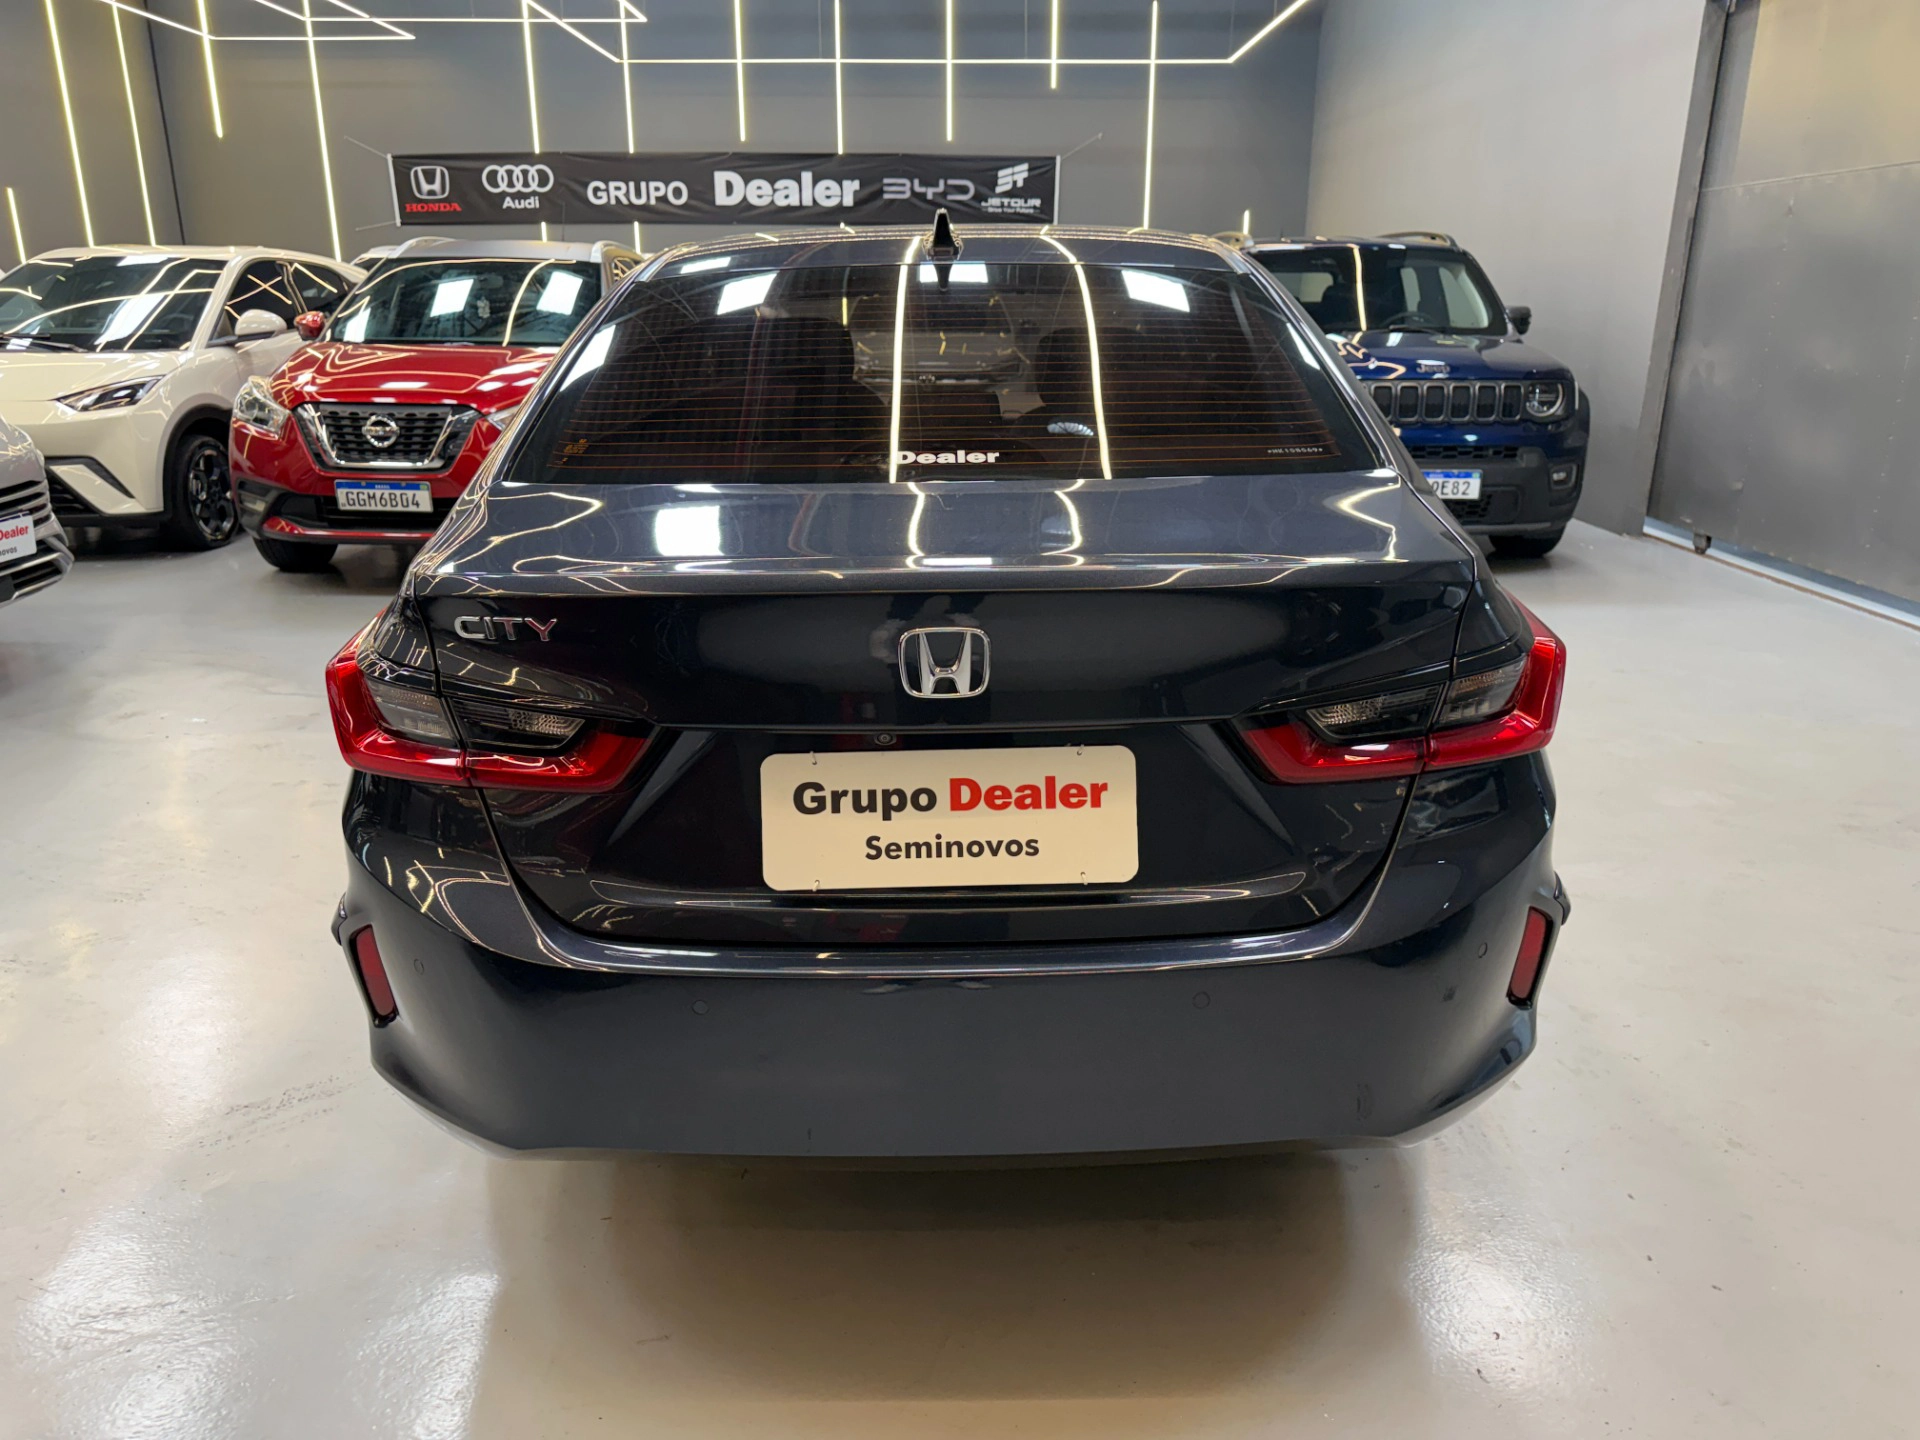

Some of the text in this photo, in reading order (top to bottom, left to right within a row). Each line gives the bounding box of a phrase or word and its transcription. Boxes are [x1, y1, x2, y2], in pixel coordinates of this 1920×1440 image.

[587, 171, 861, 207] GRUPO Dealer
[882, 177, 975, 201] BYD
[405, 202, 462, 213] HONDA
[502, 196, 540, 210] Audi
[980, 197, 1042, 208] JETOUR
[1416, 363, 1450, 373] Jeep
[897, 450, 1000, 465] Dealer
[345, 491, 421, 509] GGM6B04
[454, 616, 558, 641] CITY
[793, 775, 1108, 821] Grupo Dealer
[864, 833, 1040, 860] Seminovos
